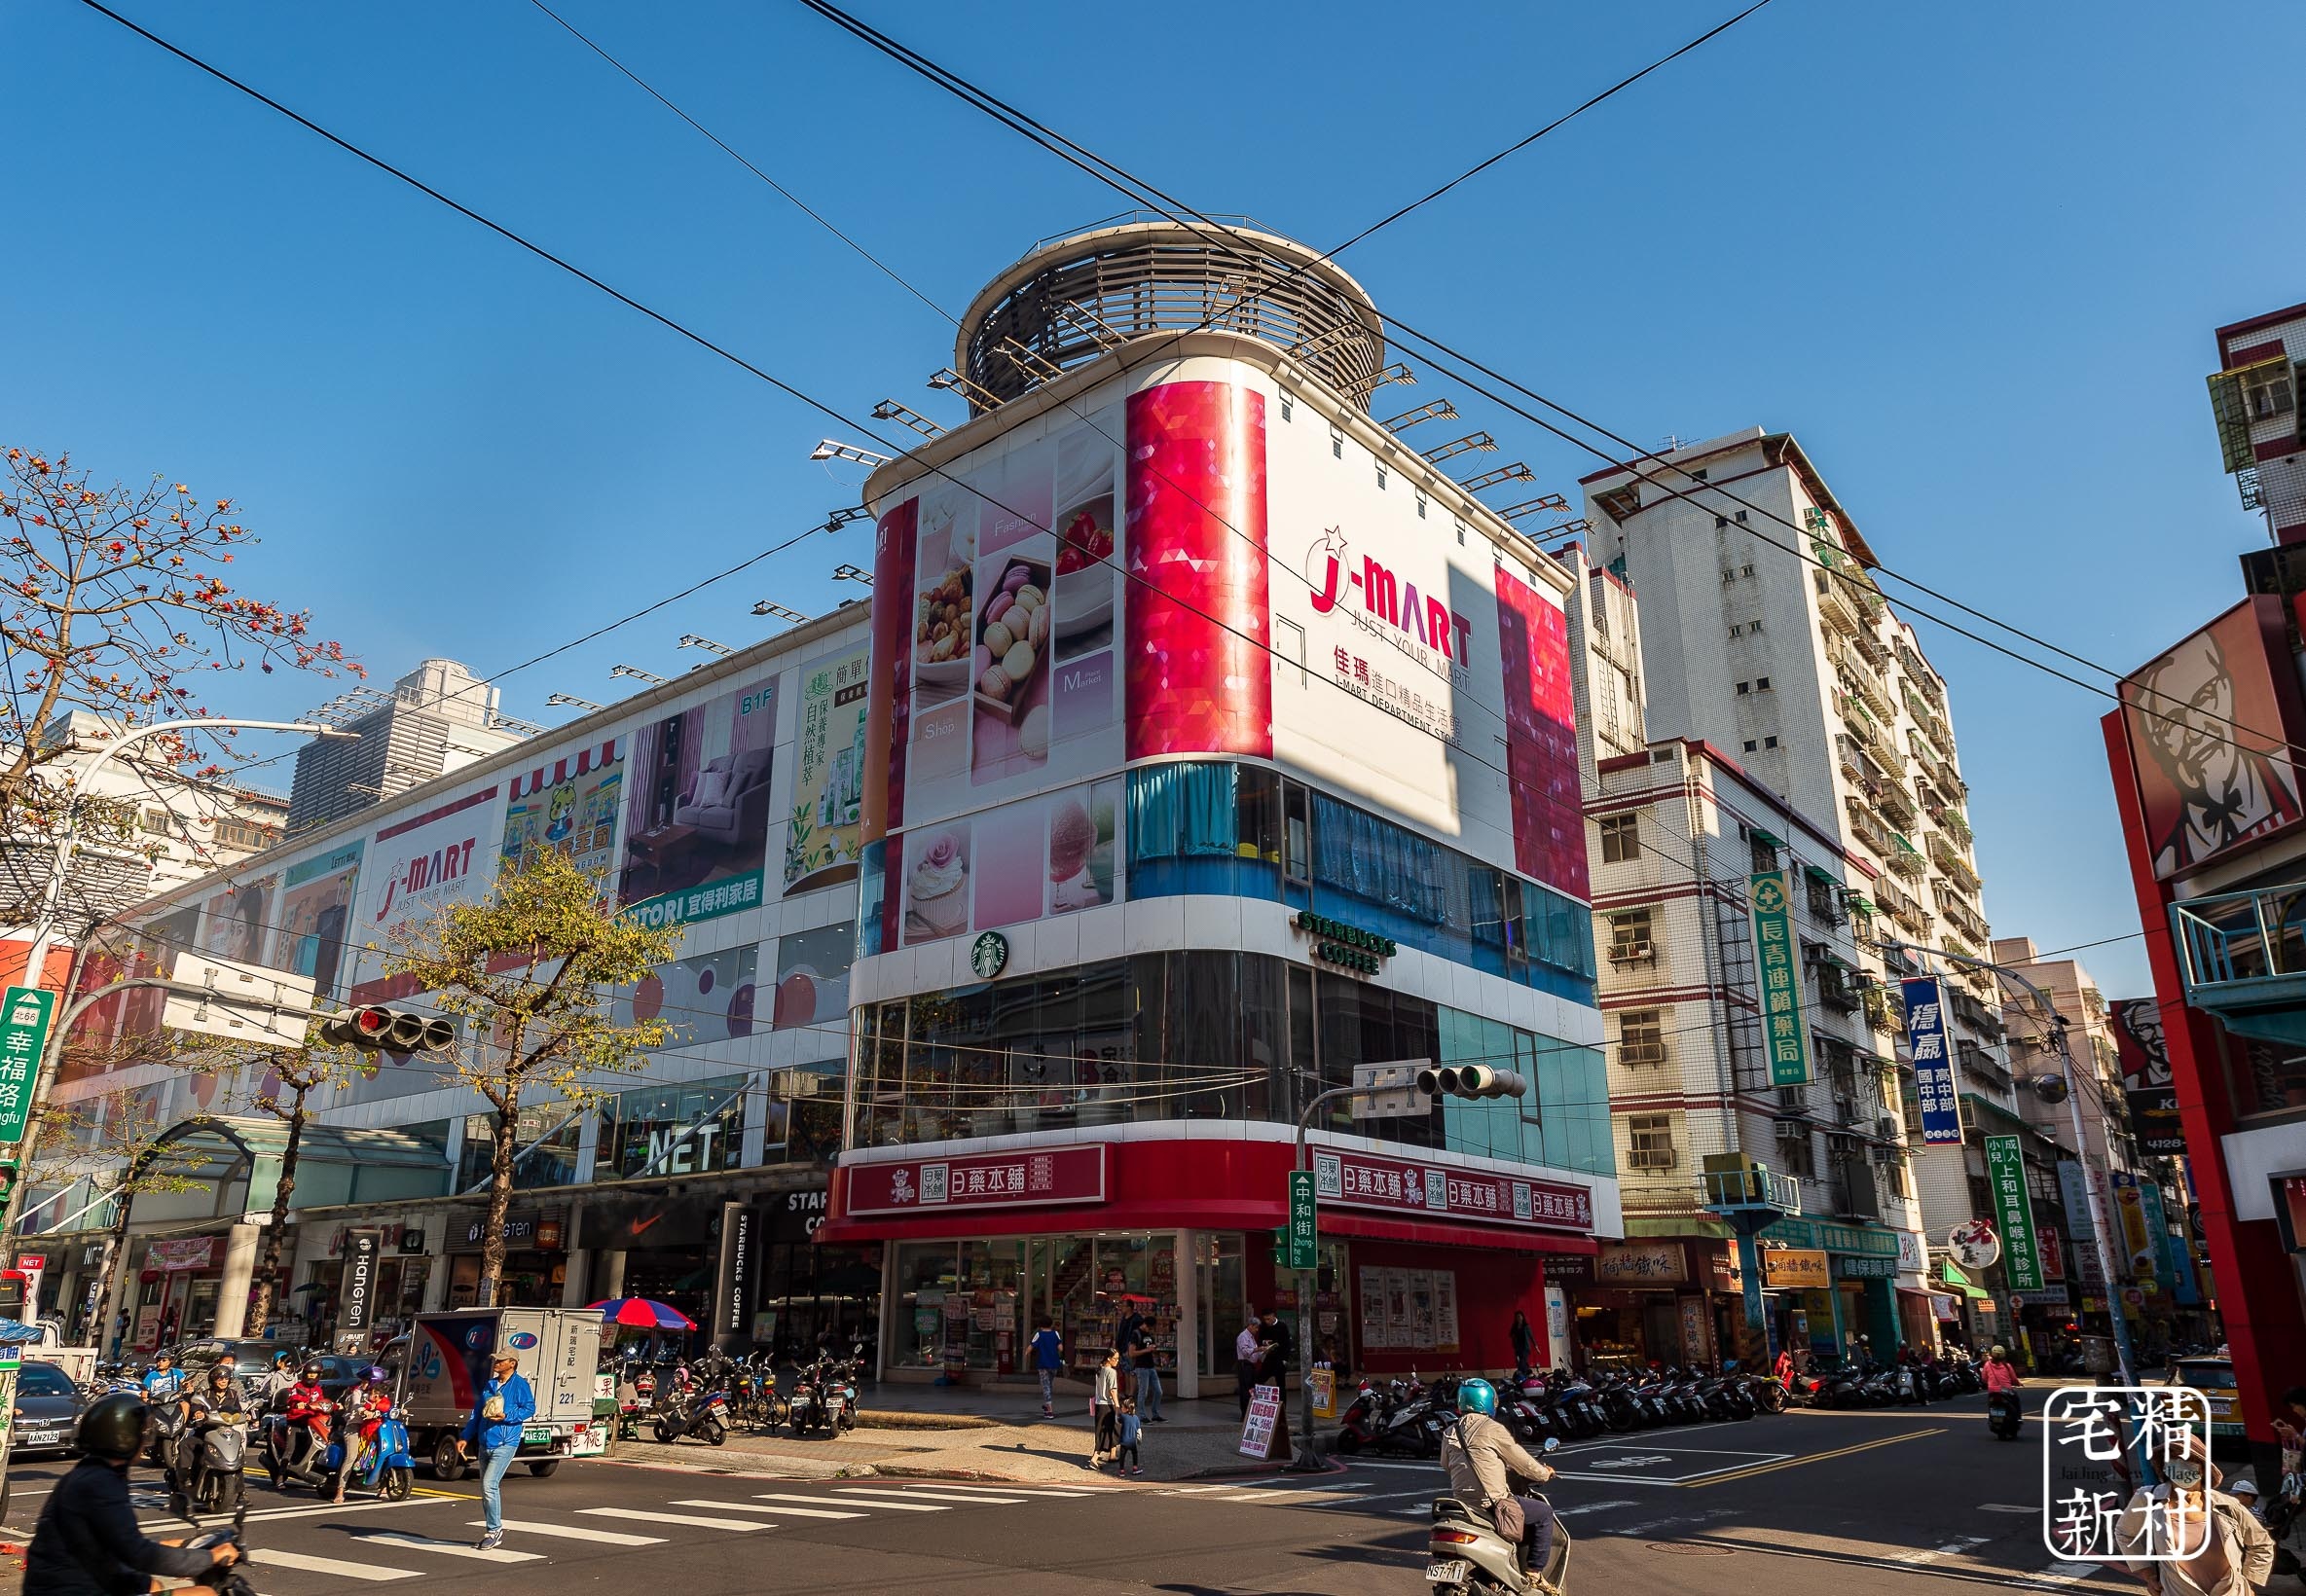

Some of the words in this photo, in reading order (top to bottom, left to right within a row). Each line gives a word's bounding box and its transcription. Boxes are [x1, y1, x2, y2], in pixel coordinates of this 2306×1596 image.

[995, 512, 1037, 537] Fashion
[1310, 555, 1472, 670] J-MART
[837, 655, 869, 686] 簡單
[1350, 609, 1386, 643] JUST
[1394, 633, 1429, 668] YOUR
[1437, 658, 1471, 692] MART
[741, 686, 773, 716] B1F
[1063, 671, 1101, 693] Market
[816, 698, 828, 767] 保養專家
[925, 722, 955, 740] Shop
[1372, 693, 1432, 735] DEPARTMENT
[801, 703, 817, 787] 自然植萃
[377, 838, 477, 923] J-MART
[573, 854, 606, 871] NGDOM
[395, 894, 416, 912] JUST
[420, 888, 440, 903] YOUR
[443, 879, 466, 896] MART
[686, 878, 757, 917] 宜得利家居
[1298, 910, 1397, 958] STARBUCKS
[1318, 940, 1380, 976] COFFEE
[1761, 920, 1800, 1064] 長青連鎖藥局
[0, 1030, 34, 1109] 幸福路
[1934, 1068, 1956, 1112] 高中部
[1918, 1069, 1938, 1113] 國中部
[646, 1123, 720, 1176] NET
[1989, 1140, 2003, 1164] 小兒
[2004, 1139, 2019, 1163] 成人
[1296, 1185, 1312, 1236] 中和街
[1999, 1164, 2033, 1288] 上和耳鼻喉科診所
[22, 1258, 41, 1267] NET
[734, 1214, 749, 1283] STARBUCKS
[1844, 1258, 1896, 1277] 健保藥局
[731, 1287, 744, 1330] COFFEE
[559, 1393, 575, 1405] 221
